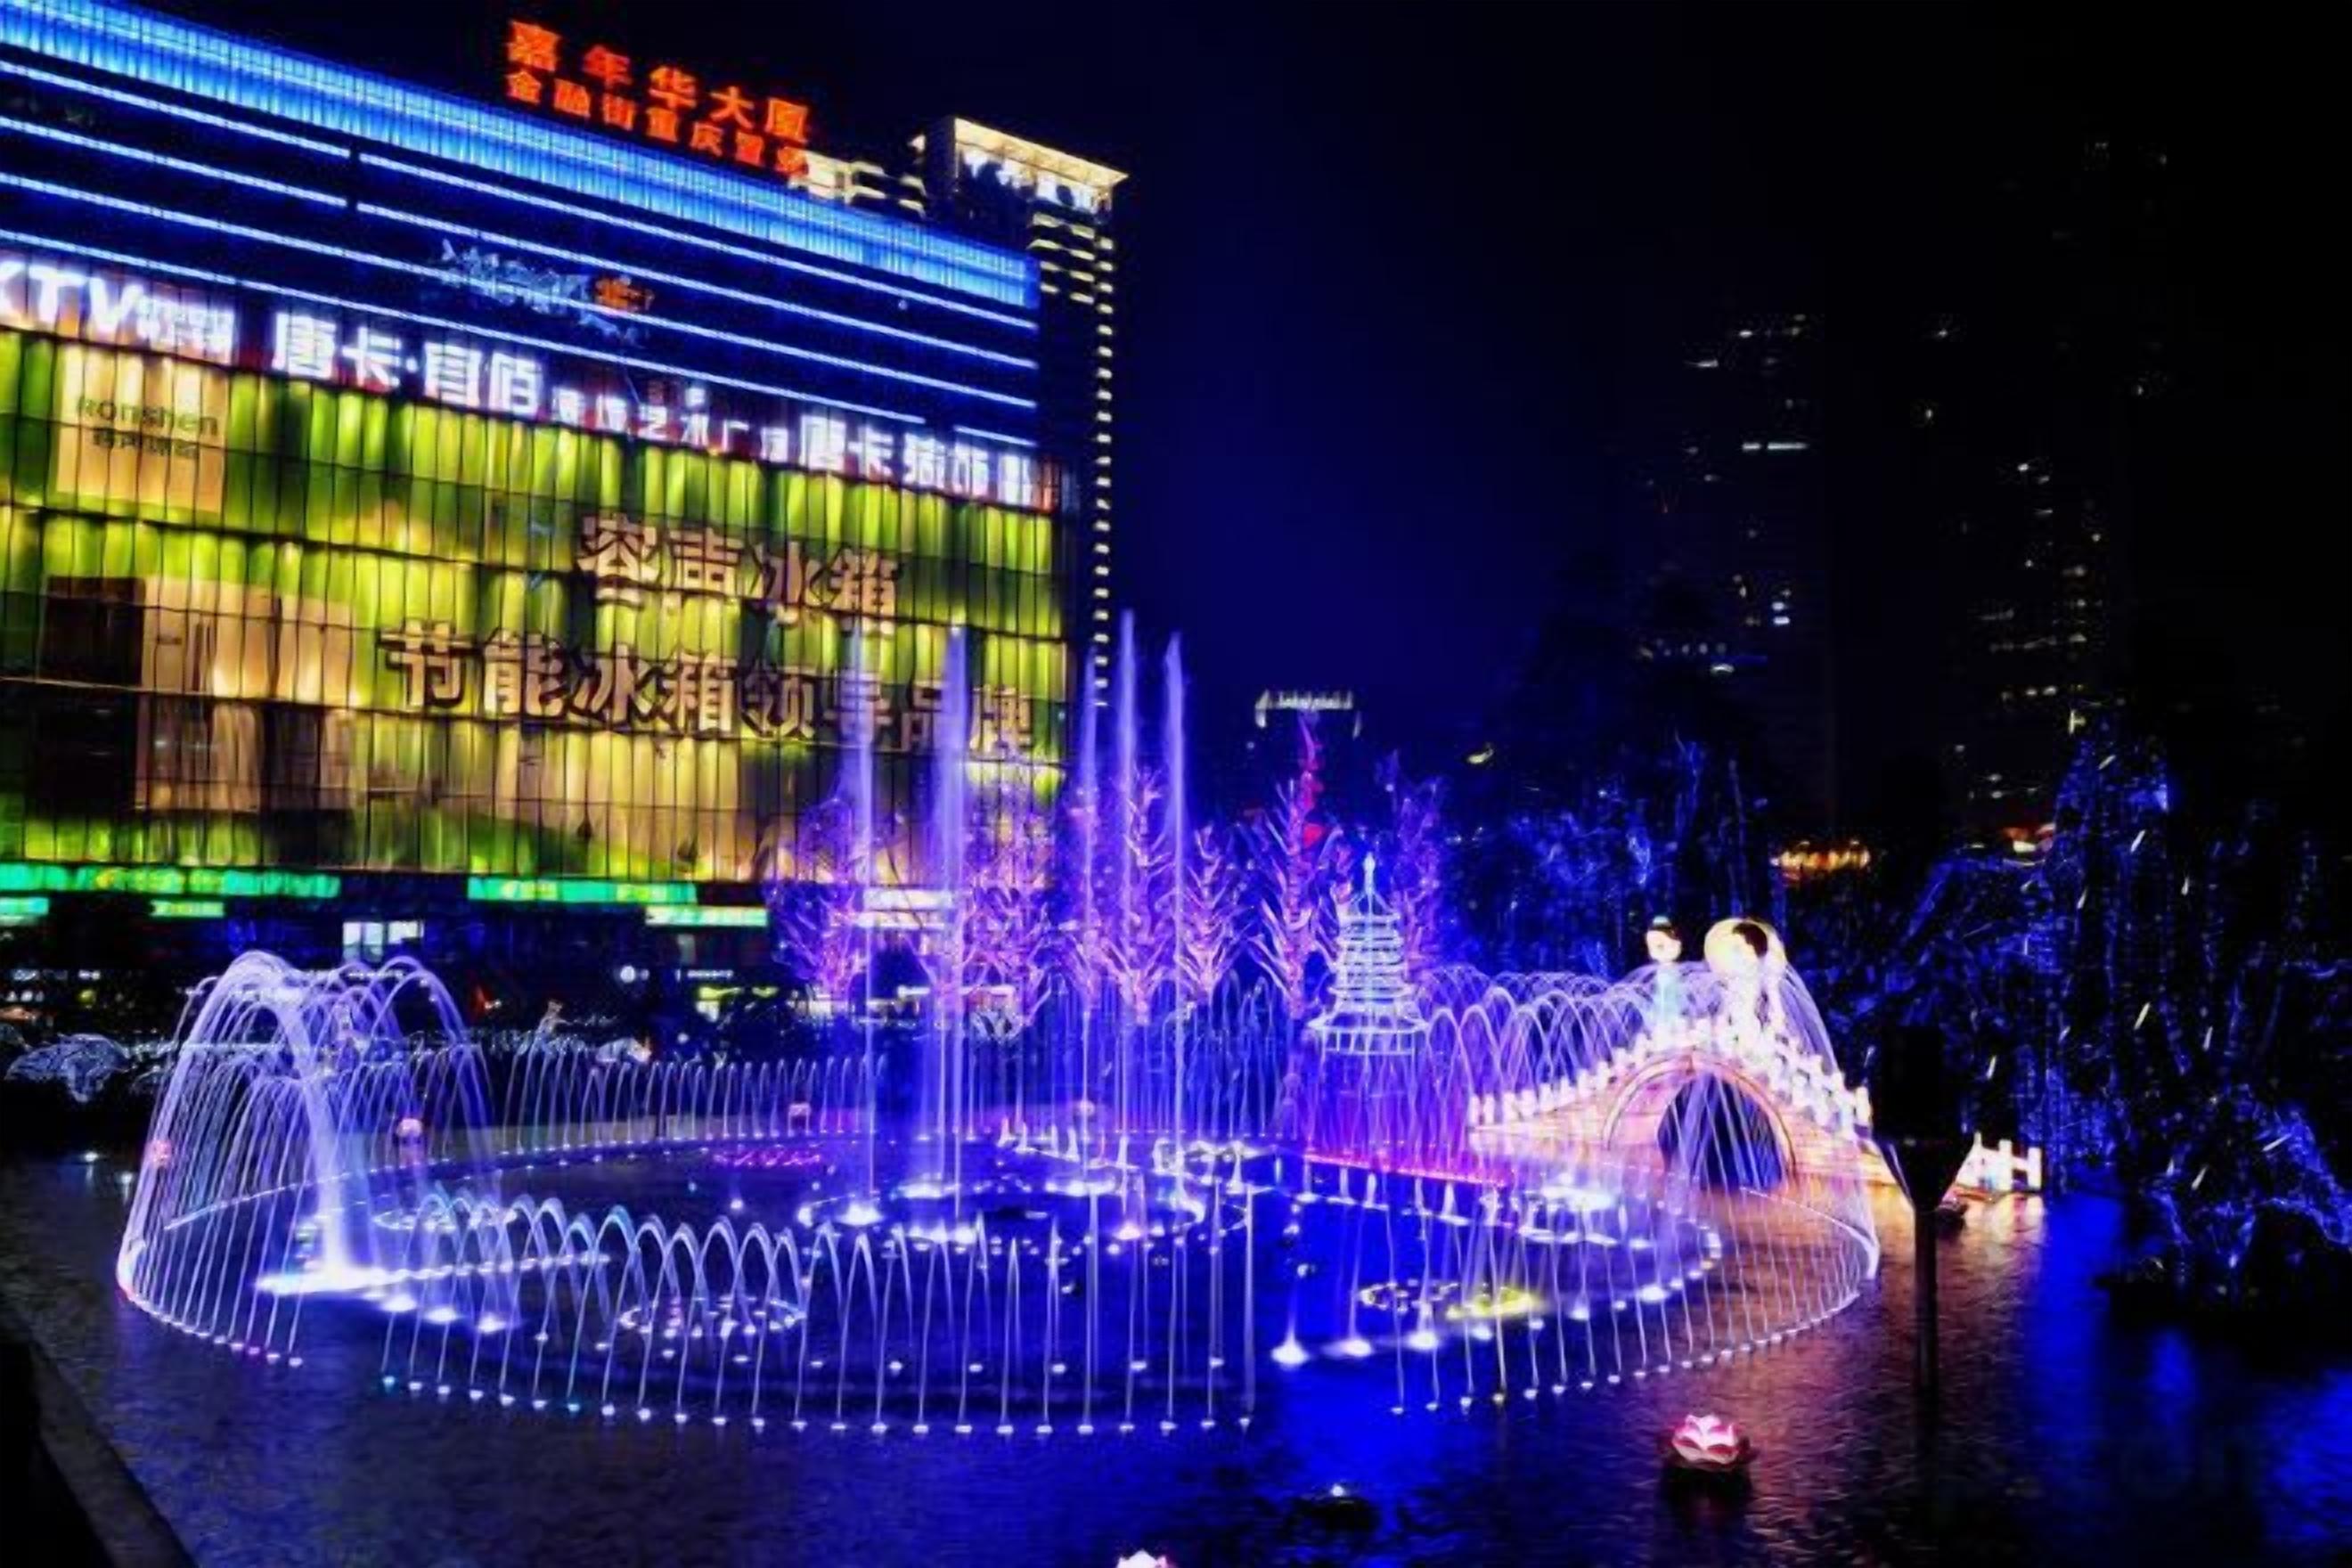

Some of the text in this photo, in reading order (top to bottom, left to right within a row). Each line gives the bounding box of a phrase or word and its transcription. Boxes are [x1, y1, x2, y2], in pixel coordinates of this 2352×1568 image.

[508, 20, 808, 143] 嘉年华大厦
[576, 510, 900, 638] 容声冰箱
